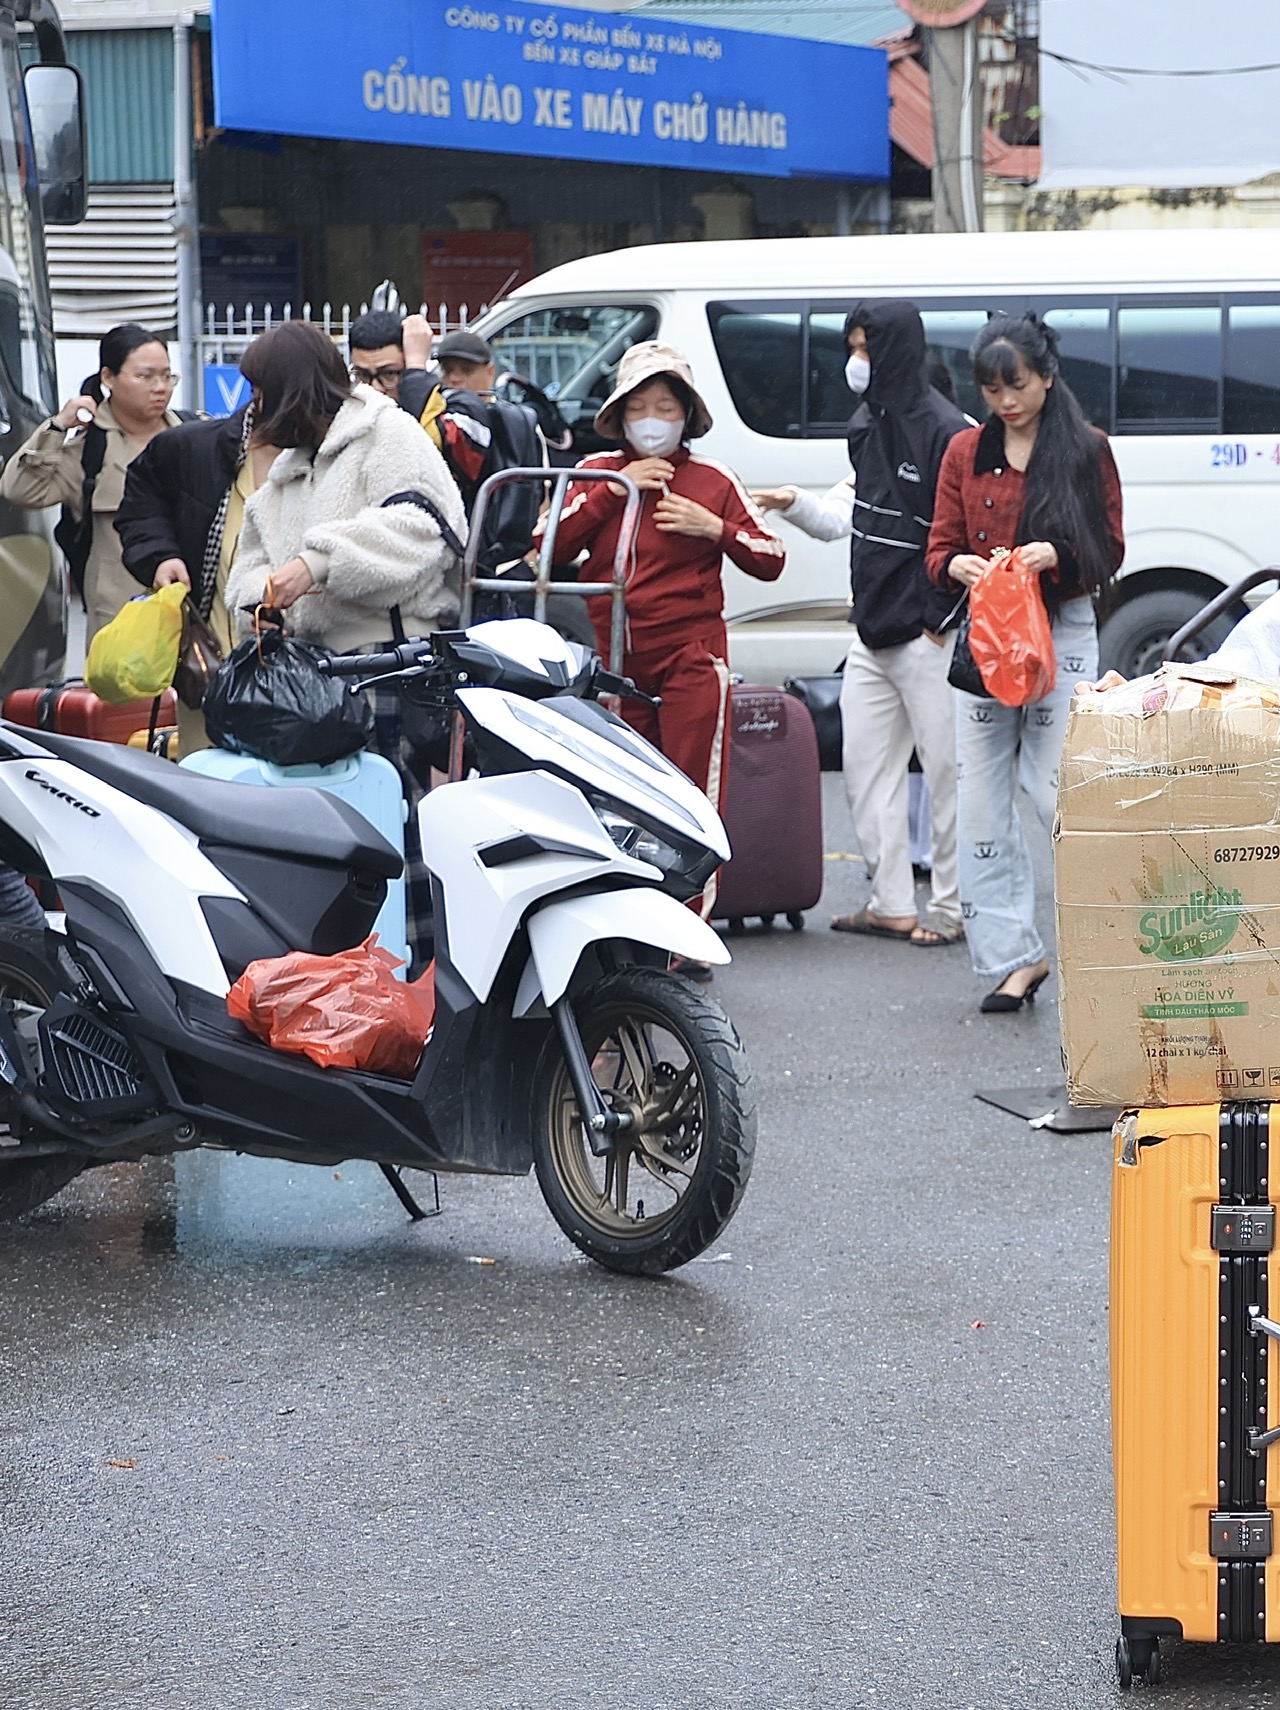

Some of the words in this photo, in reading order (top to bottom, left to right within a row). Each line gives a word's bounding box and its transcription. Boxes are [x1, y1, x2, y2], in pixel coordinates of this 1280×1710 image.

[445, 5, 500, 32] CÔNG
[505, 14, 525, 35] TY
[530, 12, 558, 39] CỔ
[562, 18, 608, 45] PHẦN
[611, 22, 641, 49] BẾN
[645, 33, 665, 52] XE
[667, 32, 691, 55] HÀ
[693, 36, 722, 63] NỘI
[523, 37, 555, 63] BẾN
[559, 46, 580, 67] XE
[583, 46, 624, 71] GIÁP
[627, 51, 658, 75] BÁT
[363, 56, 450, 118] CỔNG
[462, 73, 522, 124] VÀO
[533, 87, 573, 129] XE
[581, 88, 643, 136] MÁY
[653, 91, 709, 143] CHỞ
[715, 101, 788, 150] HÀNG
[1210, 444, 1247, 466] 29D
[1189, 764, 1213, 776] H290
[1216, 762, 1240, 778] (MM)
[1214, 845, 1280, 863] 68727929
[1139, 886, 1242, 954] Sunlight
[1175, 937, 1197, 955] Lau
[1199, 928, 1223, 943] Sàn
[1161, 968, 1180, 977] Làm
[1183, 968, 1203, 978] sạch
[1155, 990, 1182, 1002] HOA
[1185, 988, 1215, 1001] DIÊN
[1218, 986, 1235, 1000] VỸ
[1154, 1008, 1174, 1016] TINH
[1146, 1049, 1157, 1058] 12
[1159, 1047, 1177, 1057] chai
